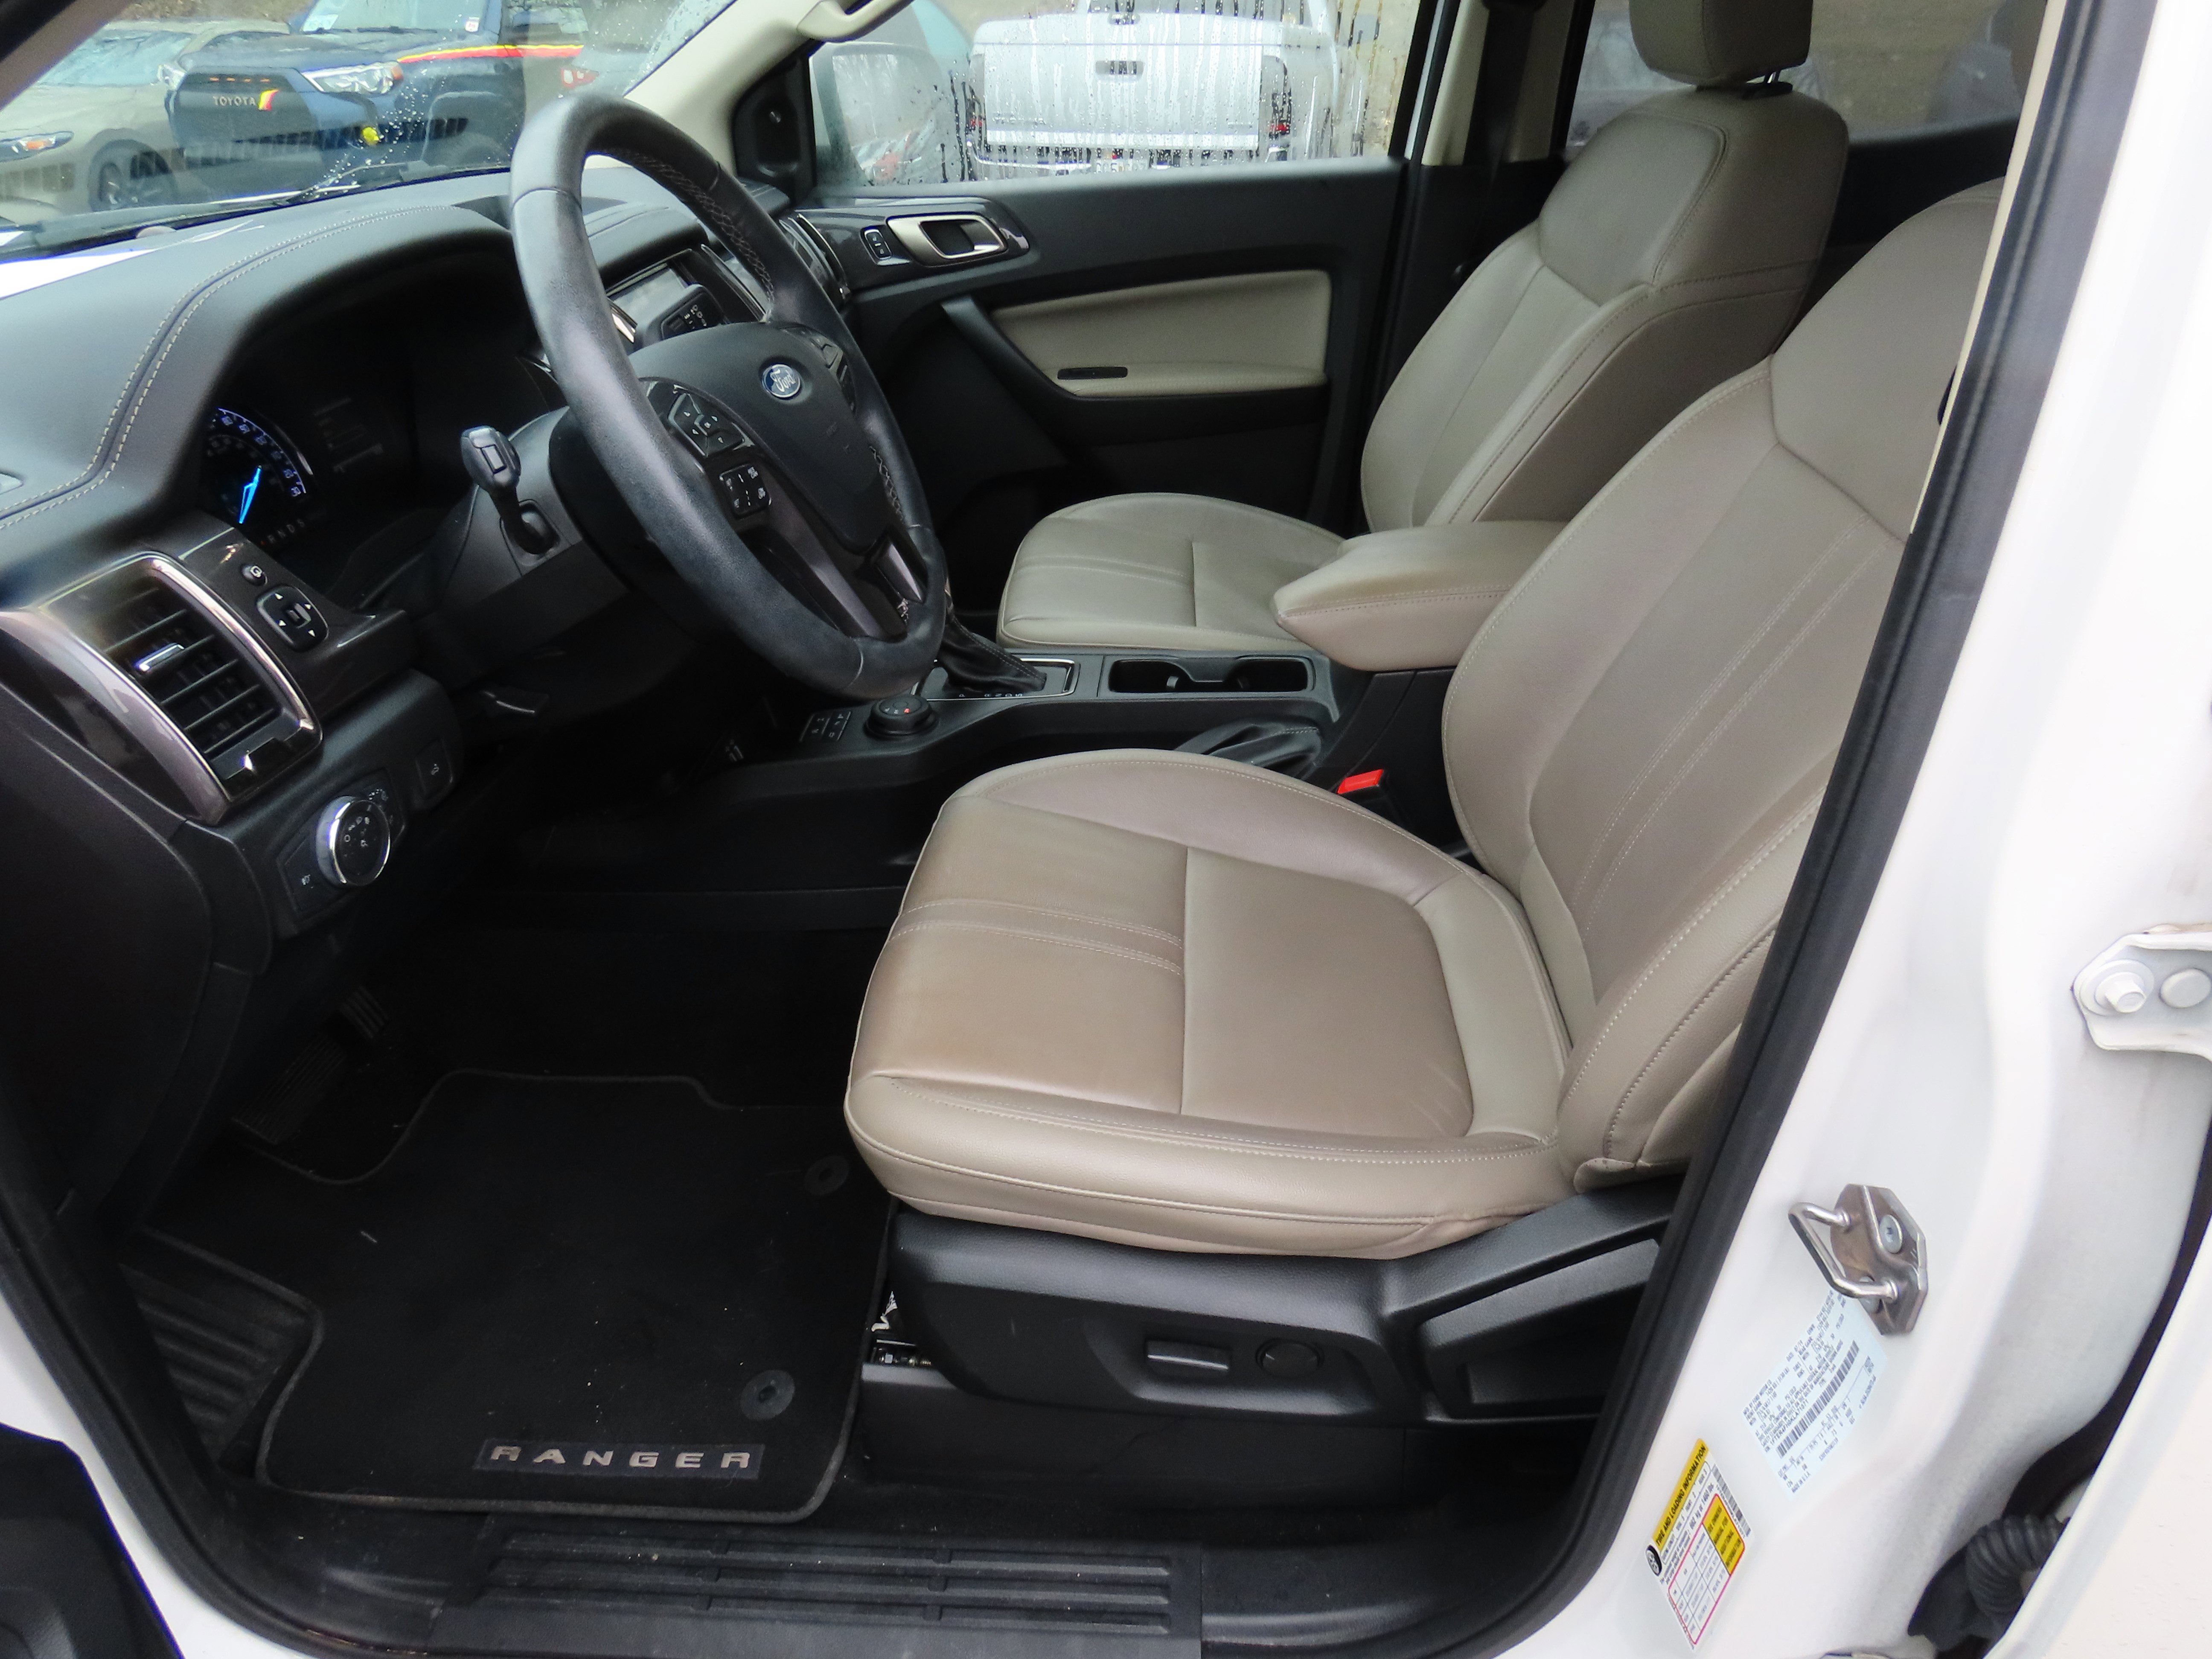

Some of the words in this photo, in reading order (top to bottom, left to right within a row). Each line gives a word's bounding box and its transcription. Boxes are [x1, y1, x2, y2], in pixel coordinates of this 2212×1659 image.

[213, 91, 256, 106] TOYOTA
[770, 369, 796, 392] Ford
[491, 1446, 751, 1468] RANGER
[1655, 1528, 1665, 1547] TIRE
[1662, 1514, 1671, 1532] AND
[1668, 1487, 1685, 1519] LOADING
[1682, 1443, 1706, 1491] INFORMATION
